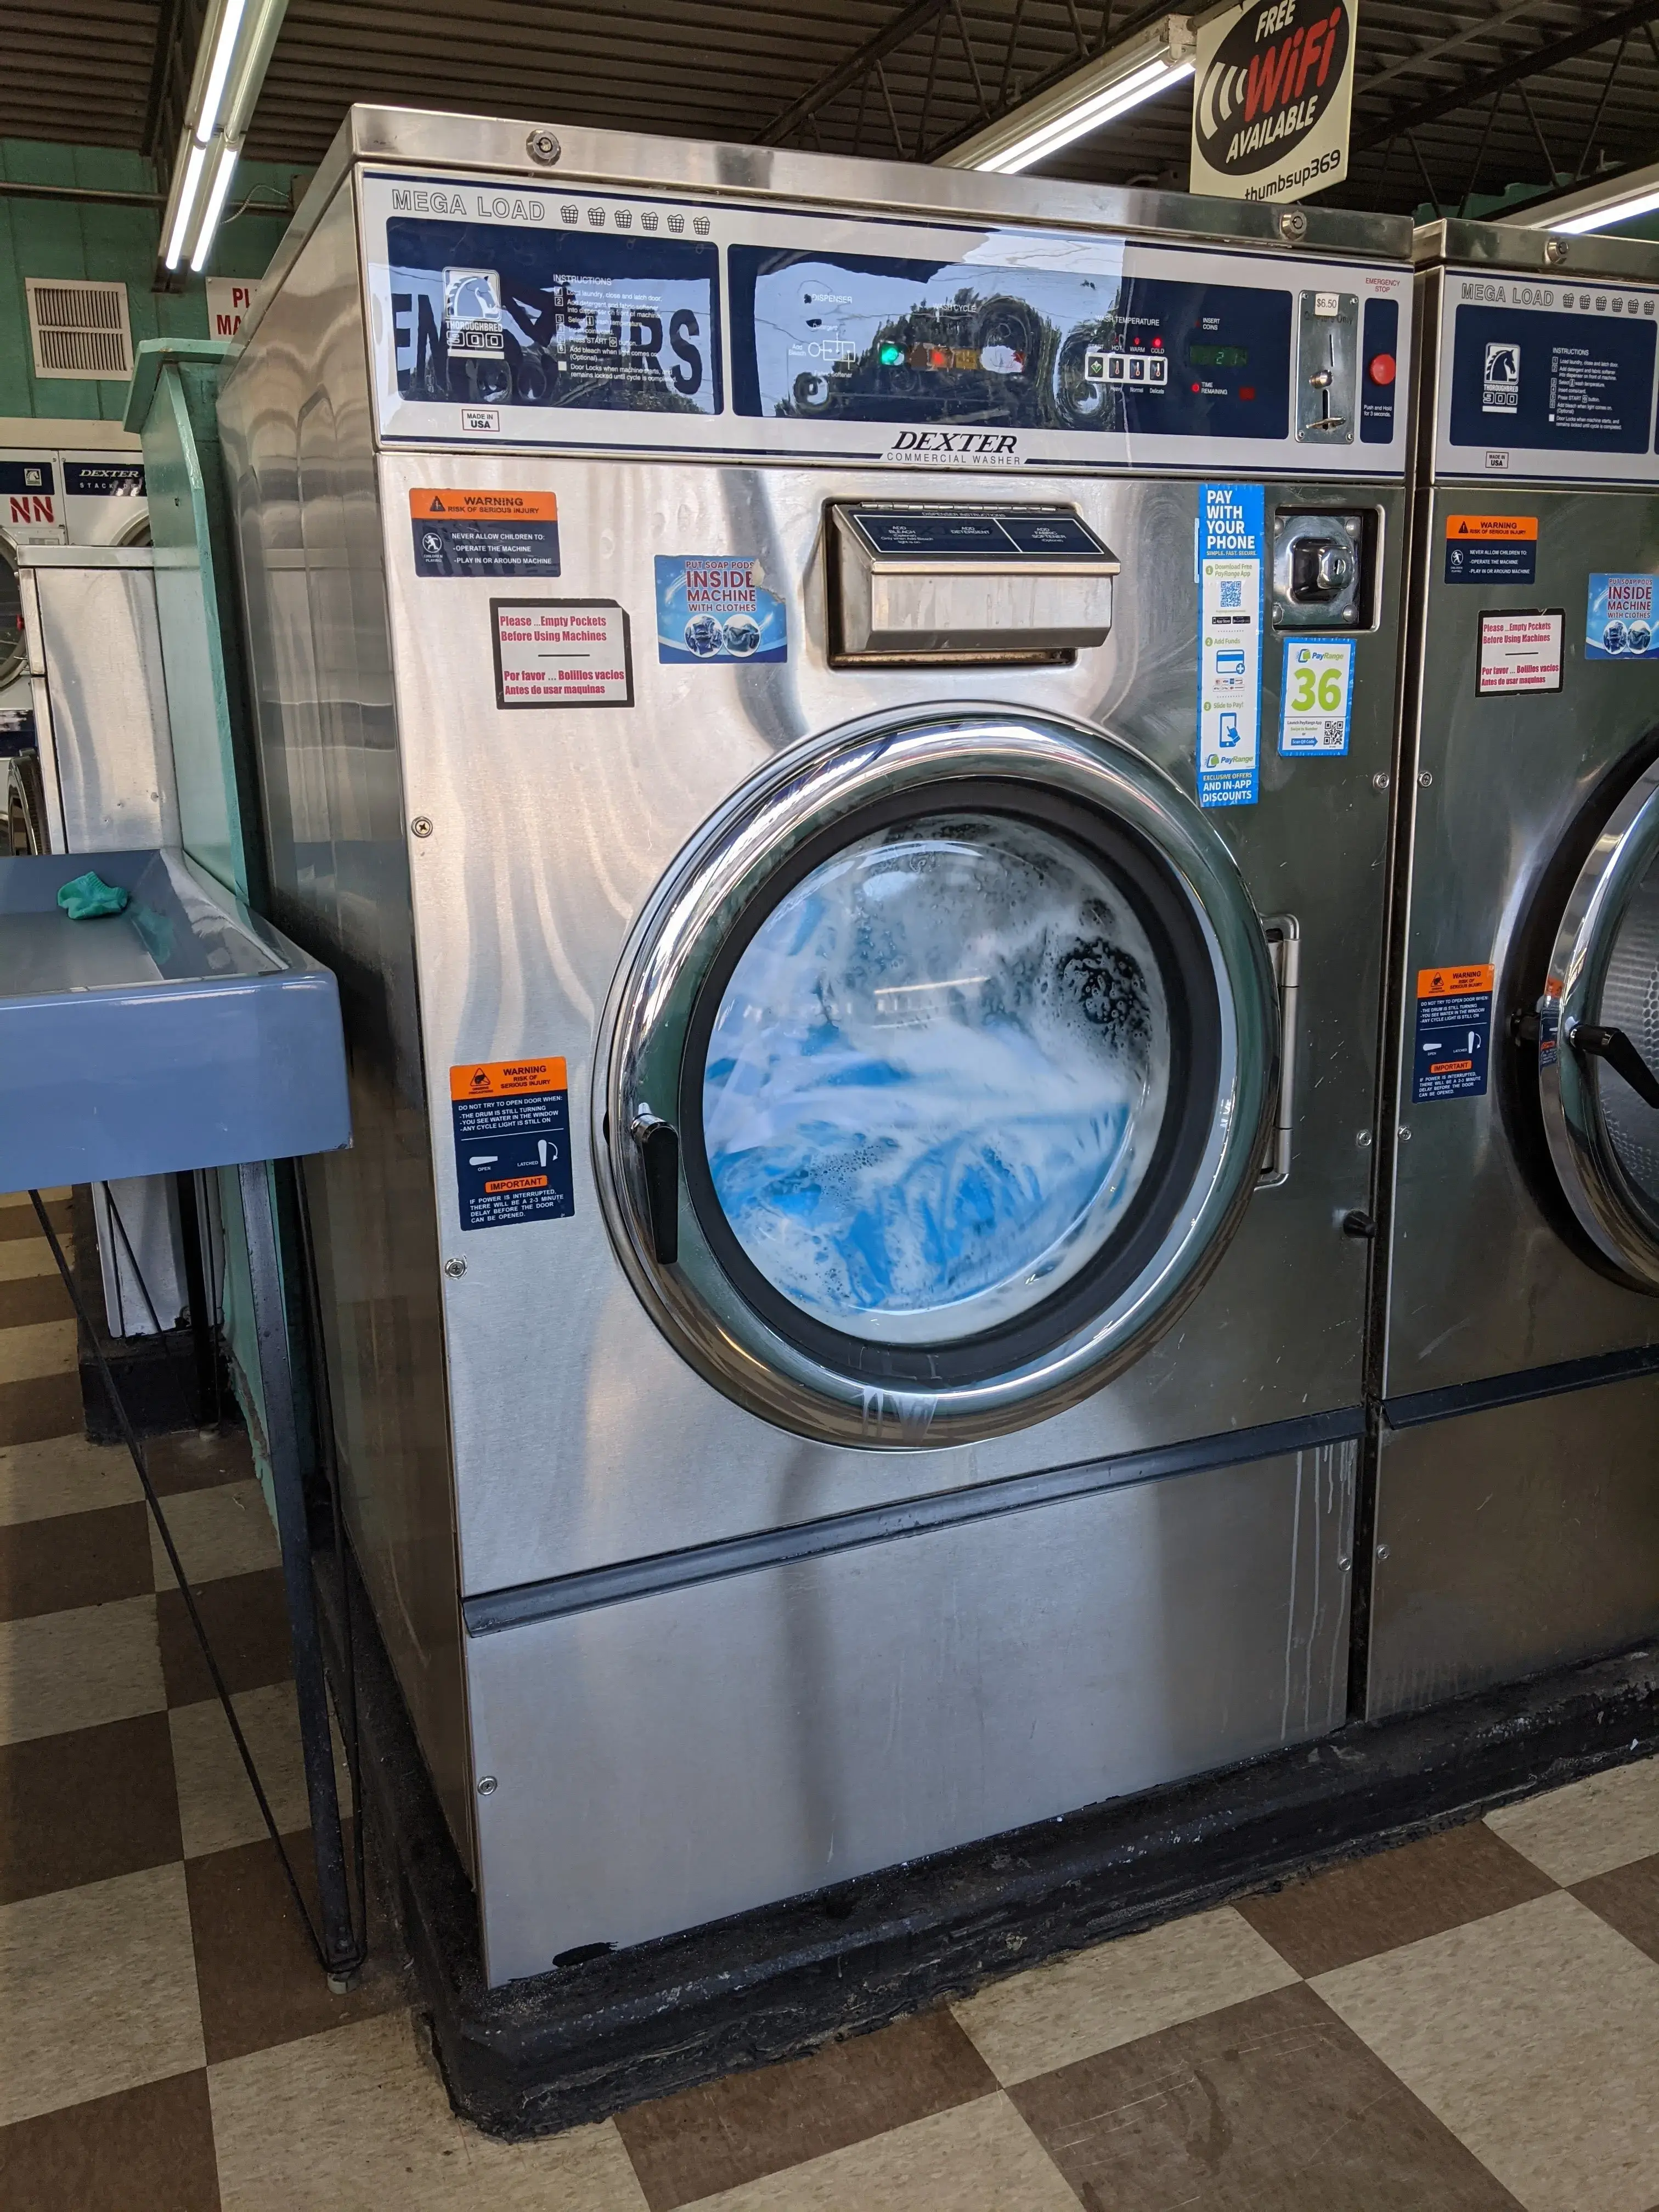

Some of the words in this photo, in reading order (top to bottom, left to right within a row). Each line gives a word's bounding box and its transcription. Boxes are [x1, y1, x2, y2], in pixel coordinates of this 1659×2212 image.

[1255, 0, 1296, 42] FREE
[1244, 7, 1341, 121] WiFi
[1226, 95, 1318, 163] AVAILABLE
[1245, 150, 1341, 201] thumbsup369
[392, 189, 466, 215] MEGA
[478, 196, 545, 221] LOAD
[553, 274, 612, 285] INSTRUCTIONS
[1365, 278, 1400, 286] EMERGENCY
[812, 294, 853, 303] DISPENSER
[1462, 283, 1505, 302] MEGA
[1513, 287, 1553, 306] LOAD
[953, 304, 977, 313] CYCLE
[1317, 298, 1336, 308] $6.50
[445, 320, 503, 332] THOROUGHBRED
[1115, 316, 1159, 326] TEMPERATURE
[1483, 392, 1518, 405] 900
[891, 431, 1017, 453] DEXTER
[887, 453, 966, 463] COMMERCIAL
[973, 455, 1020, 465] WASHER
[464, 496, 523, 506] WARNING
[1207, 490, 1232, 504] PAY
[1207, 506, 1242, 518] WITH
[1207, 521, 1244, 534] YOUR
[1207, 536, 1255, 549] PHONE
[687, 571, 755, 588] INSIDE
[687, 590, 755, 601] MACHINE
[1609, 586, 1652, 599] INSIDE
[1608, 601, 1651, 610] MACHINE
[500, 616, 531, 626] Please
[570, 616, 606, 626] Pockets
[501, 631, 532, 641] Before
[534, 631, 560, 642] Using
[562, 631, 606, 641] Machines
[504, 671, 520, 681] Por
[521, 671, 545, 680] favor
[505, 686, 529, 695] Antes
[531, 686, 541, 695] de
[564, 685, 605, 695] maquinas
[1291, 668, 1342, 711] 36
[1221, 756, 1253, 764] PayRange
[1203, 782, 1221, 791] AND
[1223, 780, 1251, 789] IN-APP
[1203, 791, 1251, 802] DISCOUNTS
[503, 1065, 546, 1075] WARNING
[1434, 1063, 1469, 1071] IMPORTANT
[490, 1178, 542, 1190] IMPORTANT
[513, 1189, 556, 1199] INTERRUPTED,
